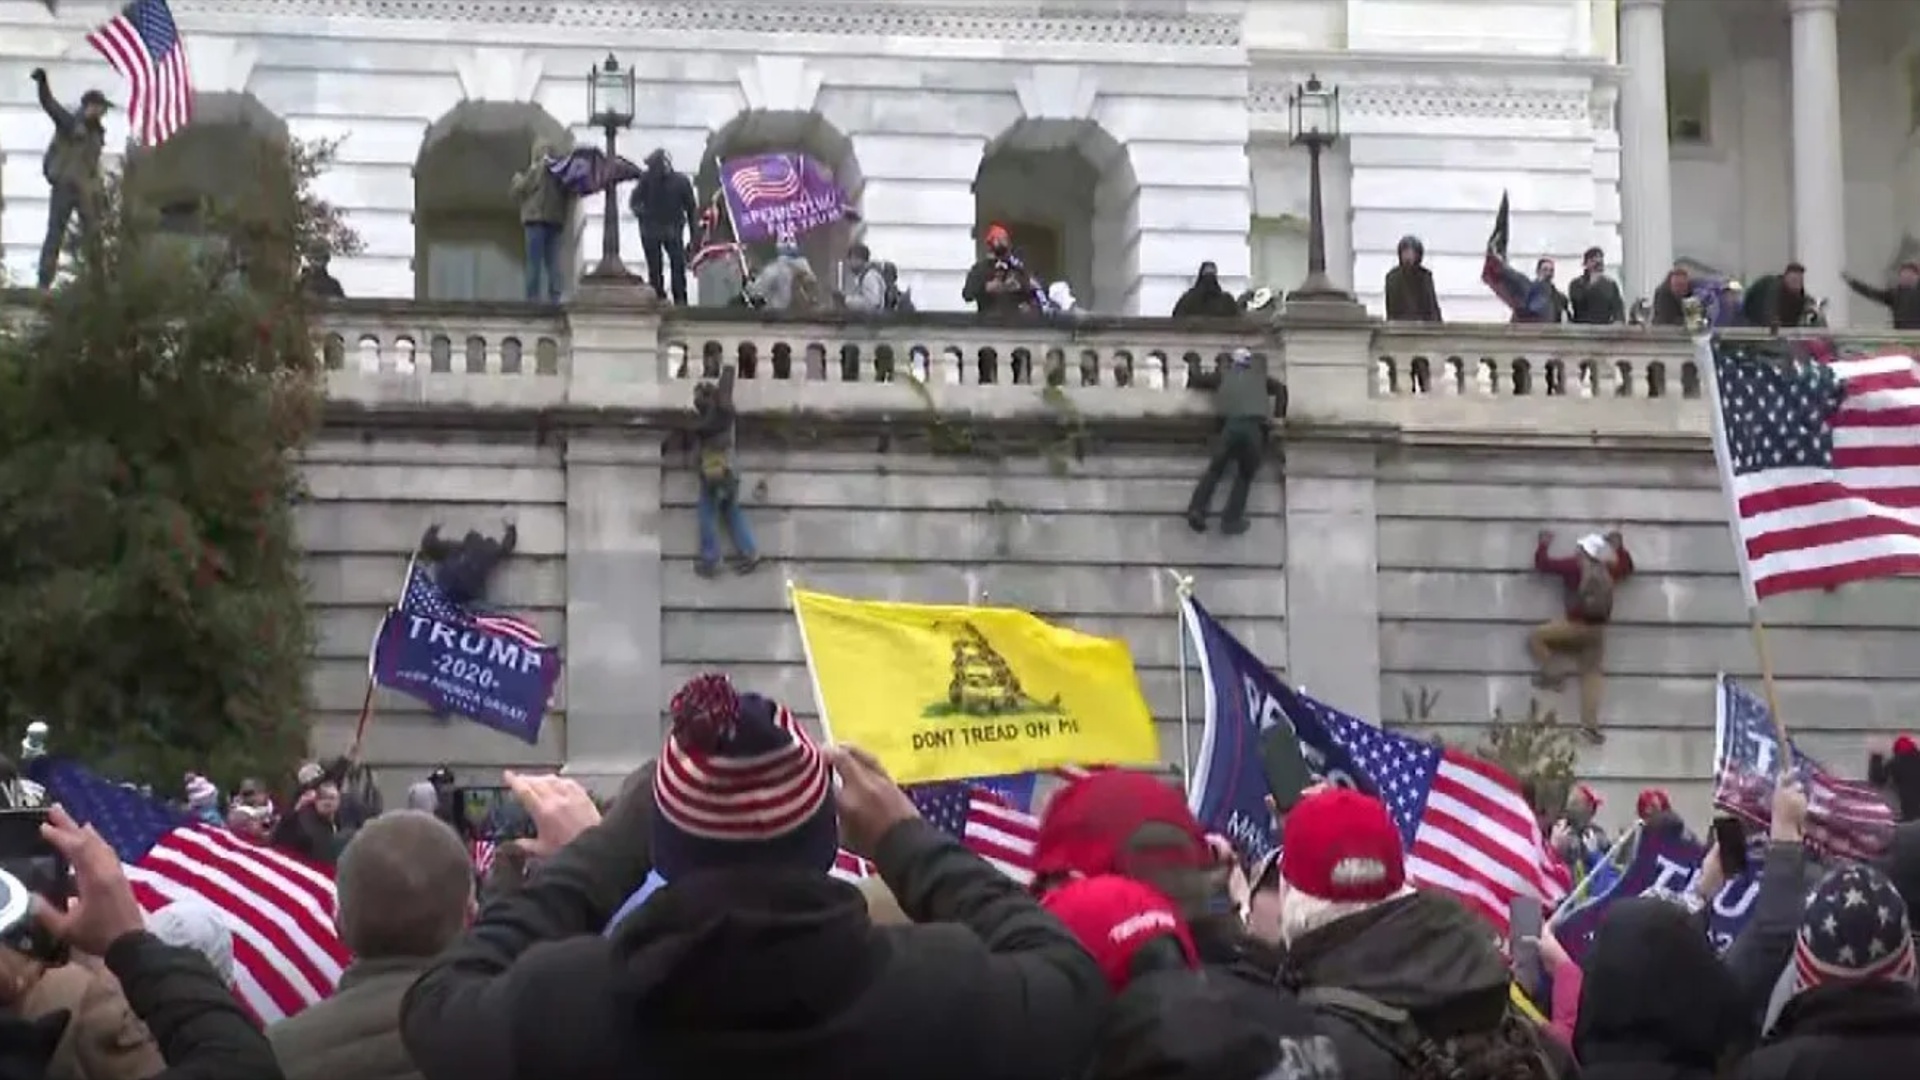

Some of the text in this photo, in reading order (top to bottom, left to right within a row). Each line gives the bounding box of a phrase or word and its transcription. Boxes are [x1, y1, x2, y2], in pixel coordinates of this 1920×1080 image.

[409, 615, 542, 673] TRUMP
[913, 729, 955, 750] DONT
[961, 724, 1018, 746] TREAD
[1026, 720, 1050, 738] ON
